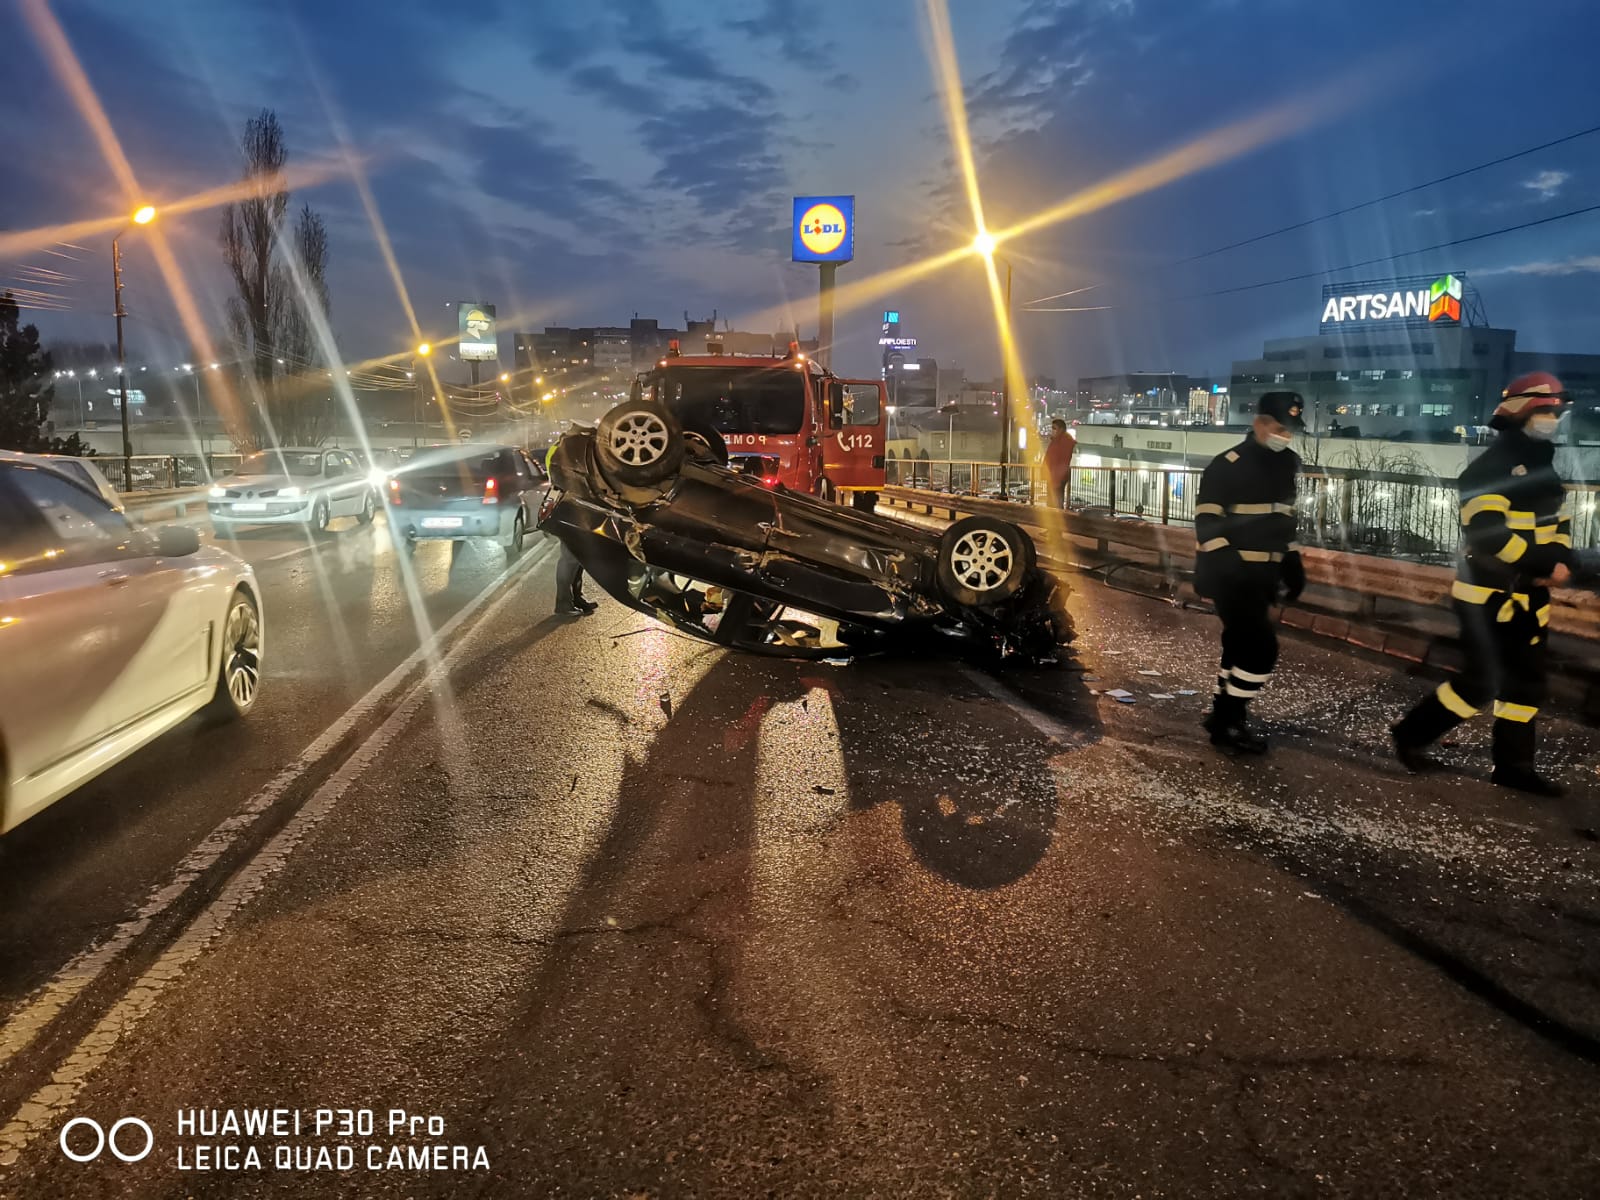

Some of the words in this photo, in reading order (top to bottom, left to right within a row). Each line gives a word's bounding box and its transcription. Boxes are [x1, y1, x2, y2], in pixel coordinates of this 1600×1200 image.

[804, 219, 842, 235] LIDL
[1321, 289, 1431, 323] ARTSANI
[848, 434, 873, 448] 112
